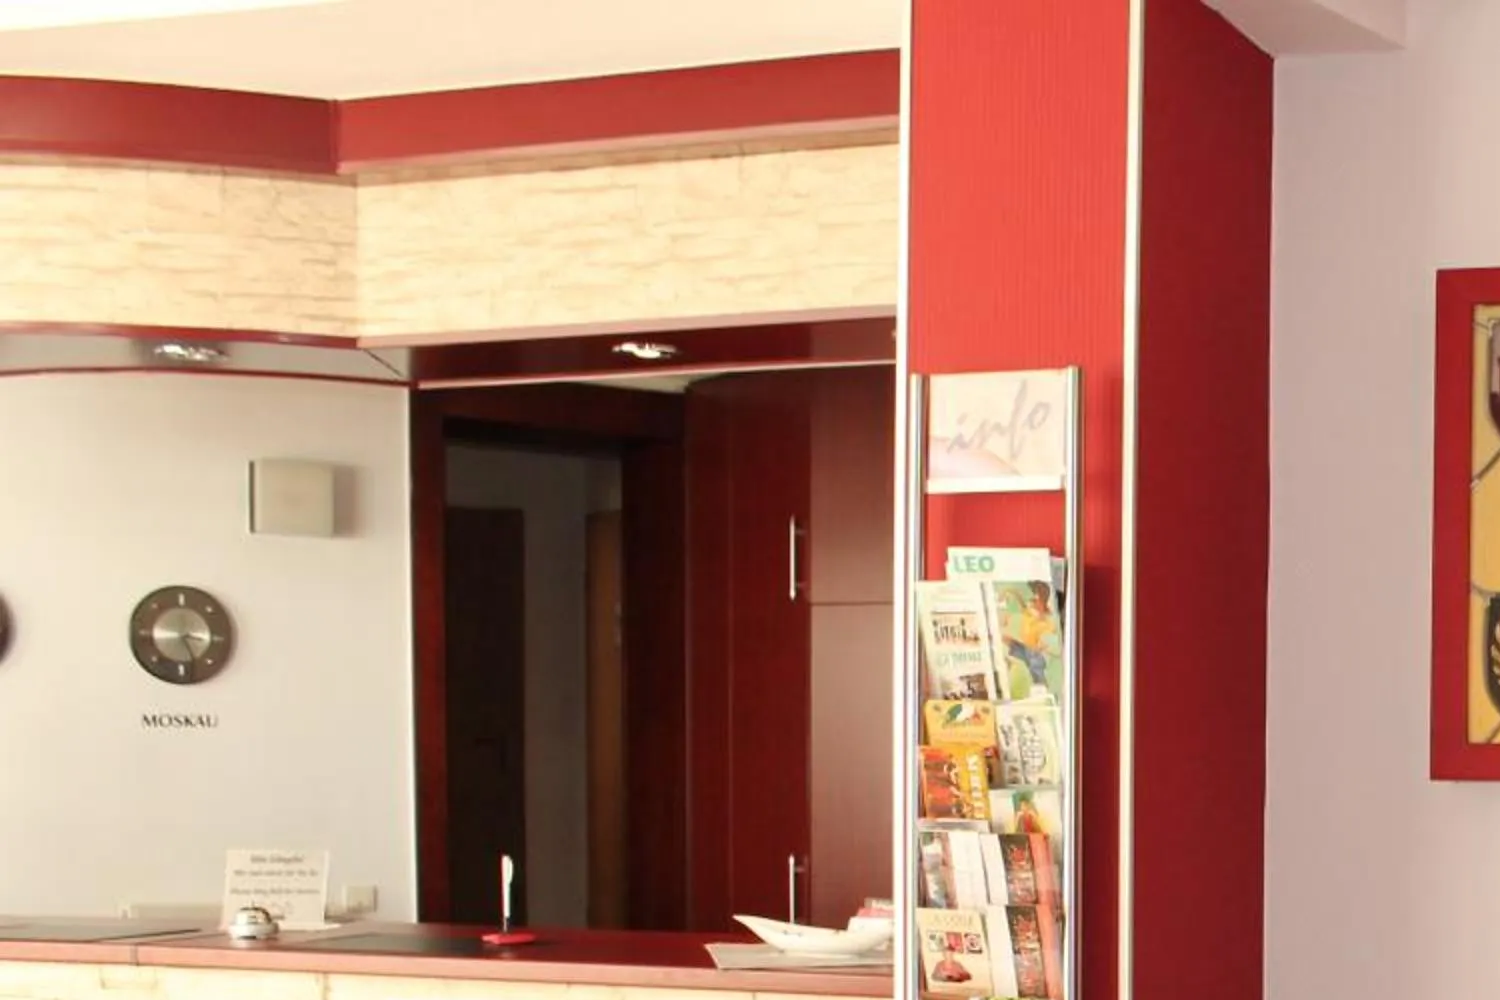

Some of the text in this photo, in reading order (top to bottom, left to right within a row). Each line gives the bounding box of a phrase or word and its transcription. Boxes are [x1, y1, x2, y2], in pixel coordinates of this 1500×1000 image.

[946, 380, 1049, 461] info
[953, 556, 994, 573] LEO
[142, 713, 219, 728] MOSKAU
